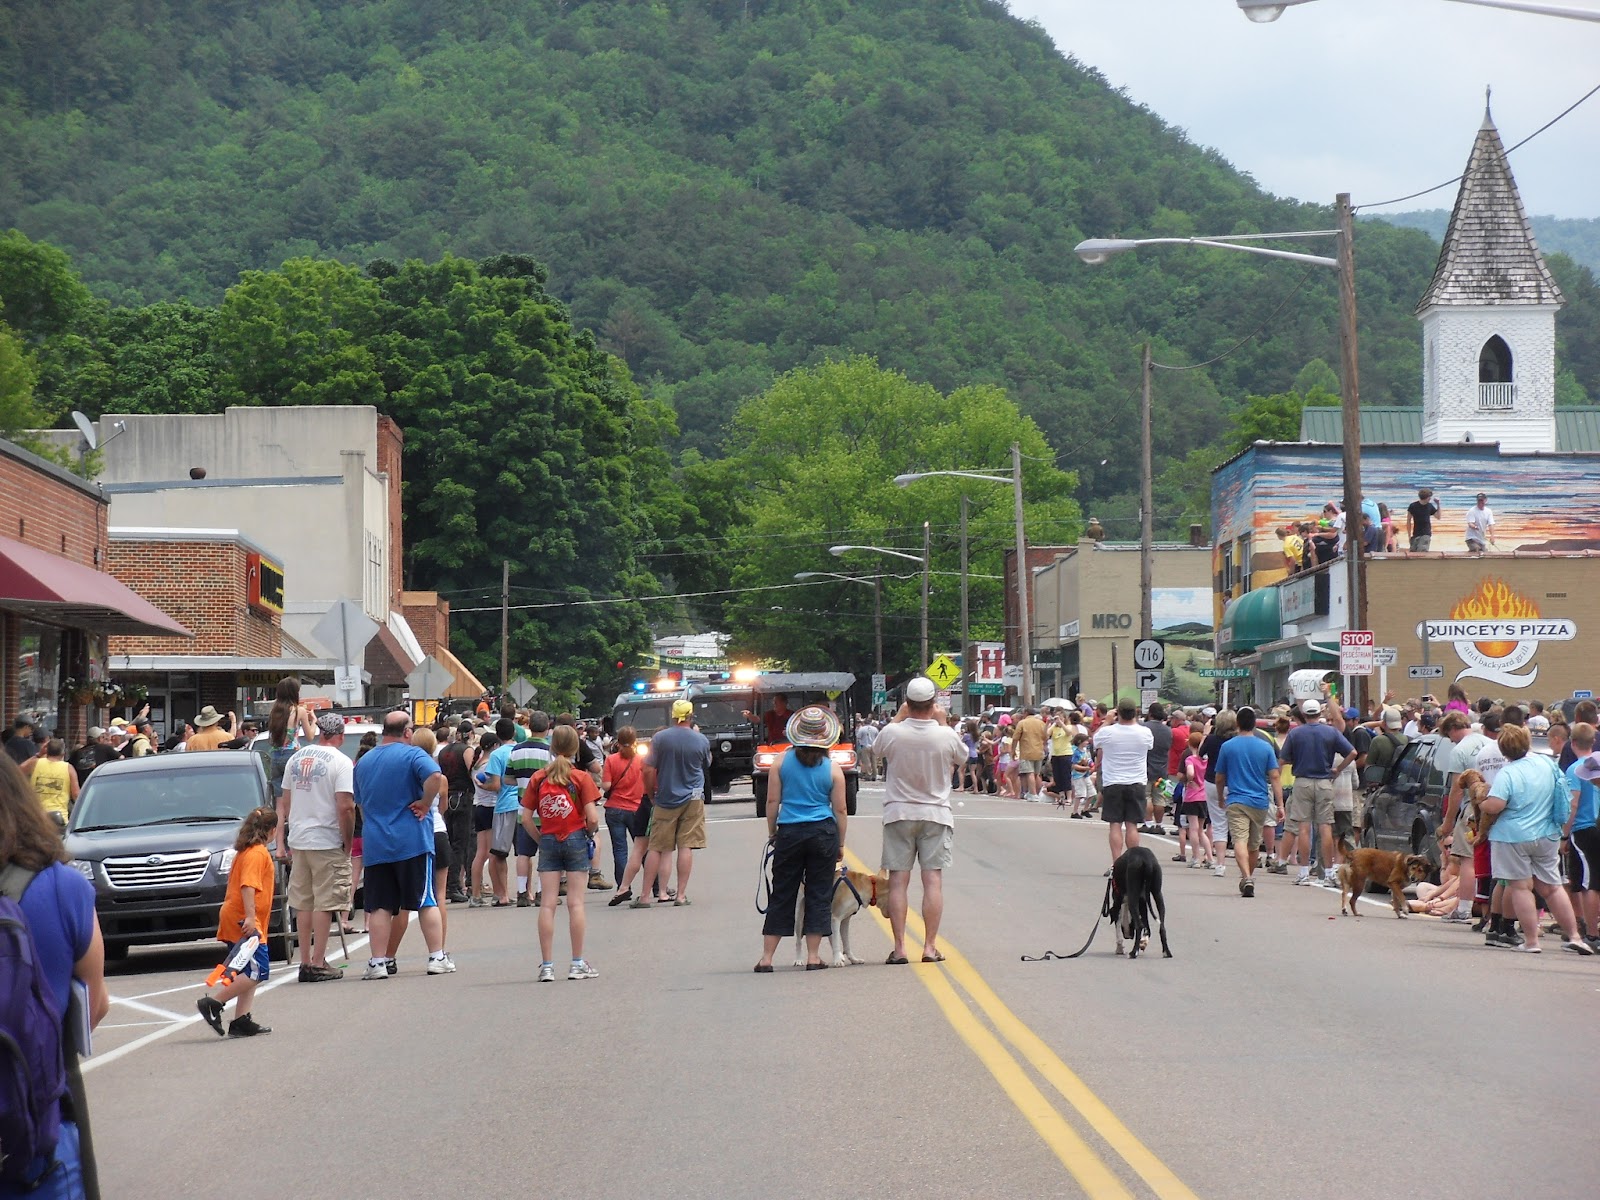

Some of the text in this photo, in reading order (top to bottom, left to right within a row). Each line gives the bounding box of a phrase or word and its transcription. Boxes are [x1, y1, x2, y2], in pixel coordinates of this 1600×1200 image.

[1092, 614, 1132, 629] MRO
[1426, 624, 1569, 637] QUINCEY'S PIZZA
[1342, 634, 1372, 645] STOP
[1140, 648, 1158, 662] 716
[1463, 645, 1529, 671] and backyard grill
[981, 650, 1002, 678] H
[293, 749, 334, 763] CHAMPIONS
